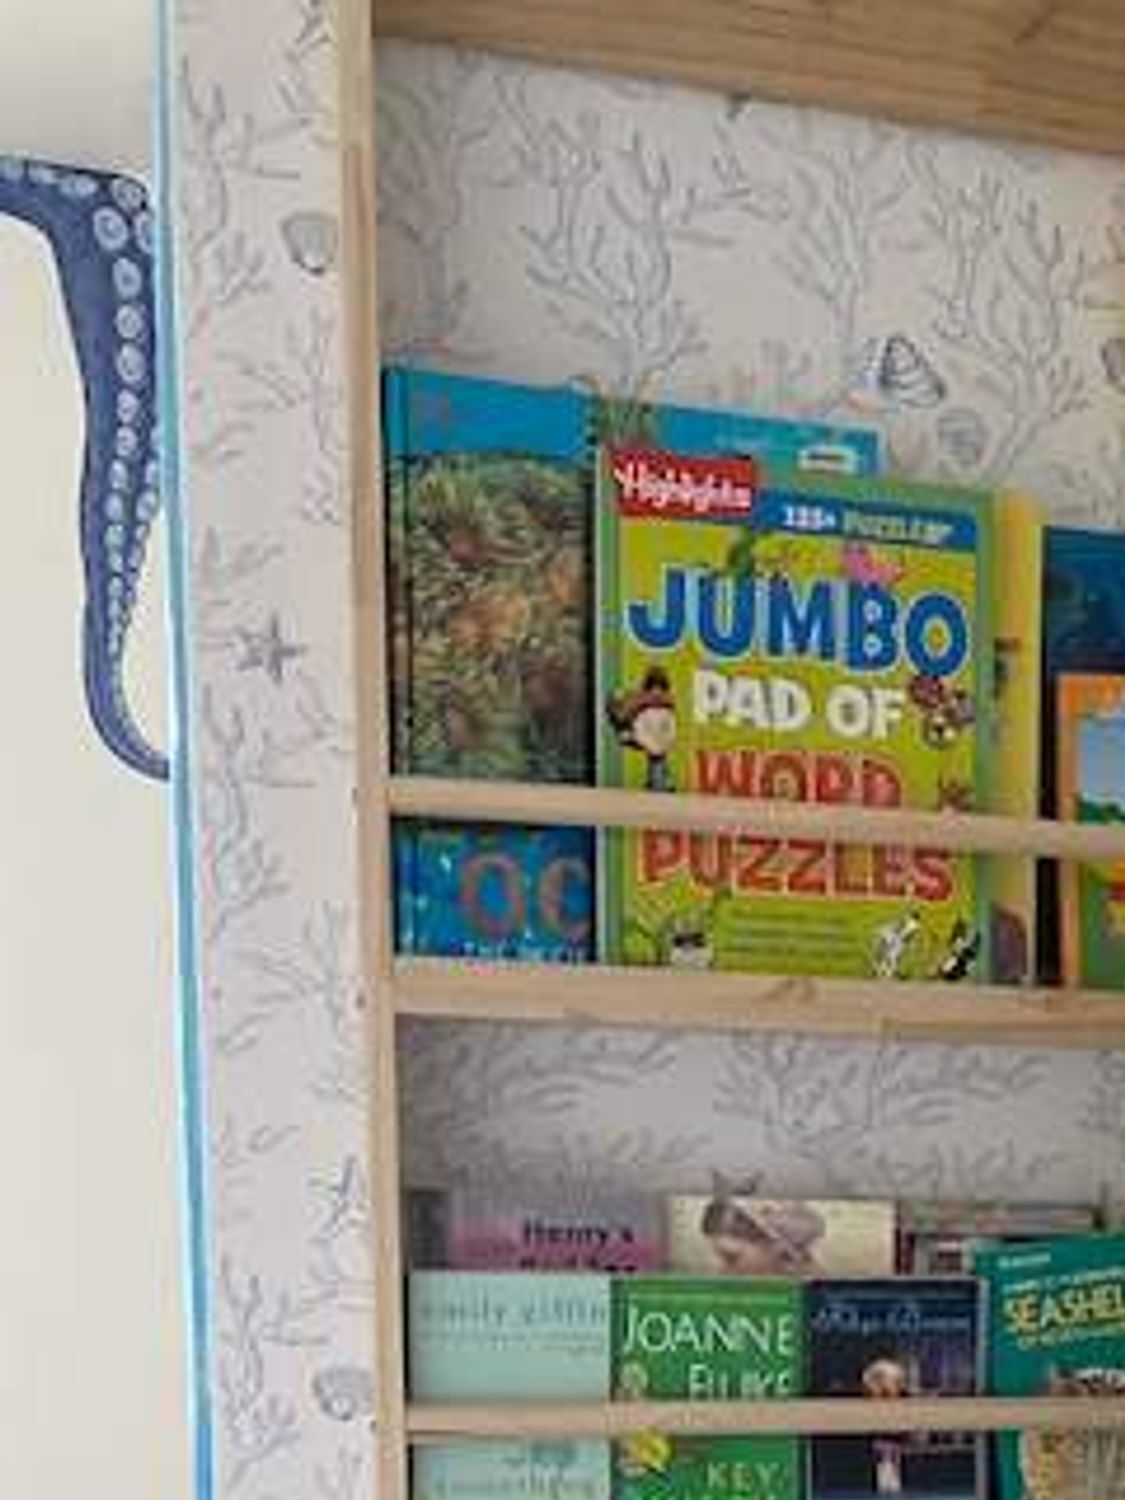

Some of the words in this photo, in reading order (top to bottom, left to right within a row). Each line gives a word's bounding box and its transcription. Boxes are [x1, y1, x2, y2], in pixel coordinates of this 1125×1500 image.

[613, 458, 752, 512] Highlights
[628, 565, 971, 677] JUMBO
[694, 670, 810, 730] PAD
[825, 684, 905, 738] OF
[641, 831, 952, 902] PUZZLES
[623, 1308, 796, 1356] JOANNE
